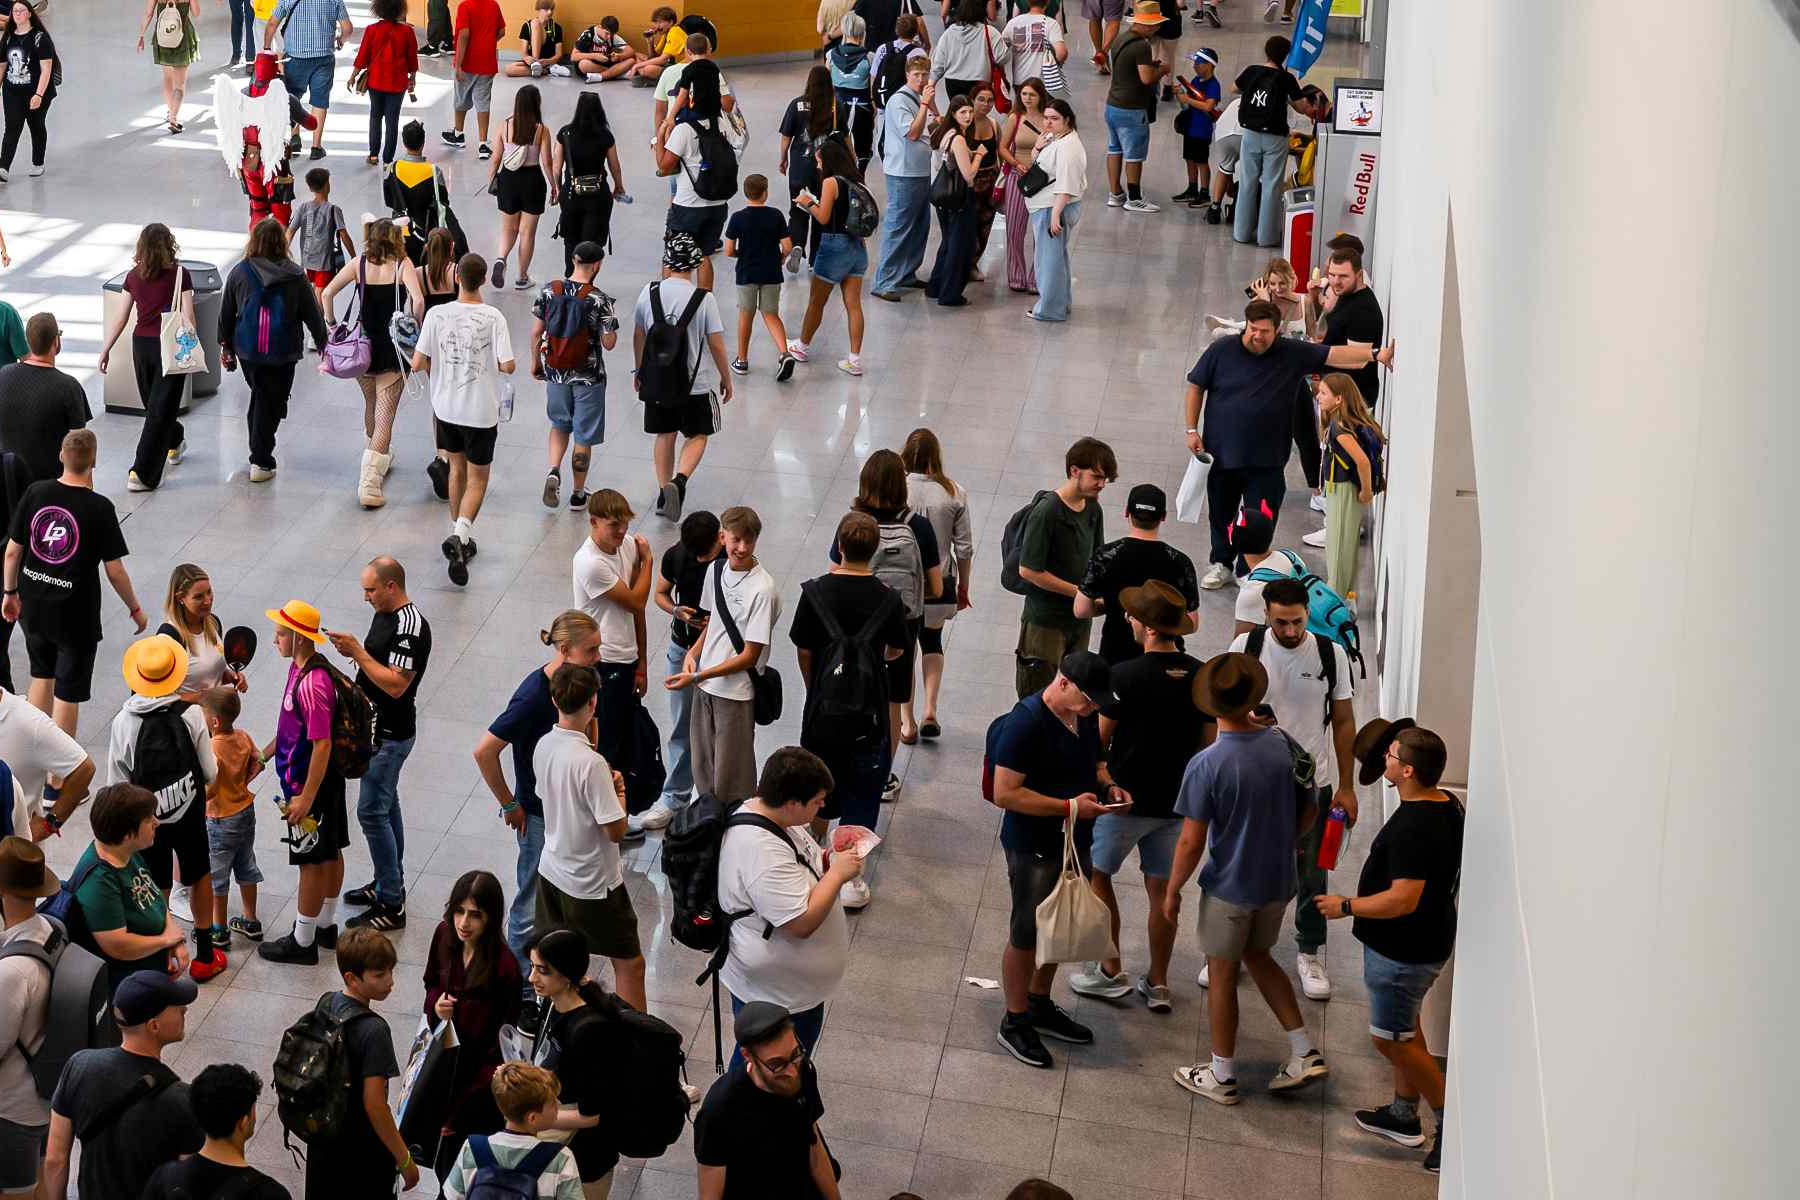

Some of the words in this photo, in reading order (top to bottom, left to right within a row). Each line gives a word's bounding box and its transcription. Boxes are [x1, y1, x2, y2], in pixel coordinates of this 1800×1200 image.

[1250, 89, 1268, 107] NY
[1356, 153, 1377, 184] Bull
[1349, 184, 1370, 216] Red
[154, 770, 197, 817] NIKE
